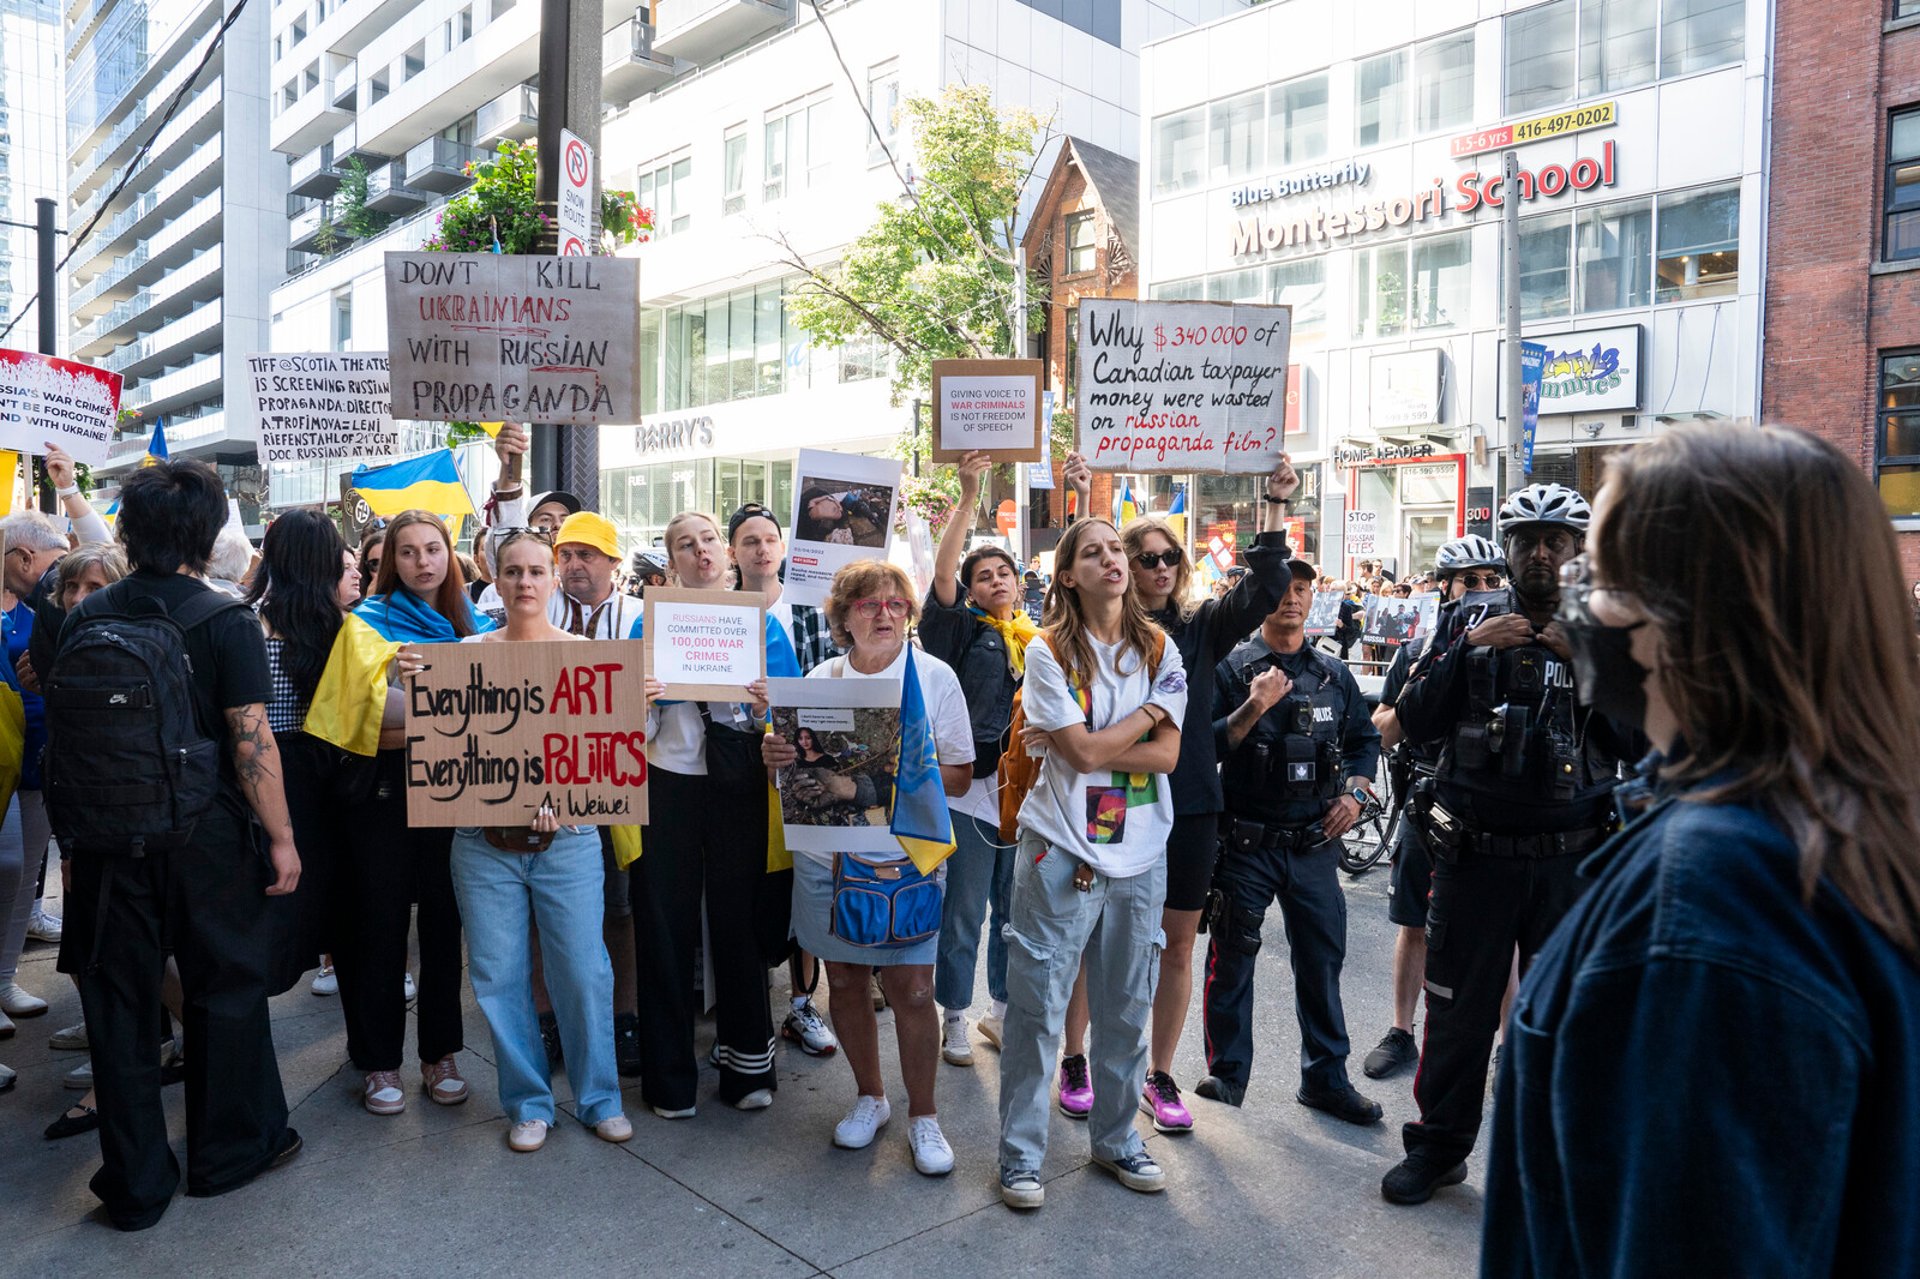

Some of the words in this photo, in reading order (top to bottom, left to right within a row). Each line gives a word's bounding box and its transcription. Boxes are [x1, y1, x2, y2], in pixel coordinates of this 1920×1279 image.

[1453, 135, 1486, 153] 1.5-6
[1489, 131, 1509, 149] yrs
[1517, 106, 1611, 139] 416-497-0202
[1231, 186, 1273, 207] Blue
[1276, 161, 1371, 199] Butterfly
[565, 189, 585, 210] SNOW
[563, 204, 586, 228] ROUTE
[1229, 177, 1447, 257] Montessori
[399, 255, 478, 286] DON'T
[536, 258, 601, 291] KILL
[418, 291, 572, 323] UKRAINIANS
[1089, 308, 1145, 364] Why
[1253, 320, 1280, 348] of
[407, 334, 470, 367] WITH
[500, 334, 609, 367] RUSSIAN
[248, 357, 277, 373] TIFF
[340, 357, 390, 372] THEATRE
[1093, 351, 1195, 385] Canadian
[1200, 356, 1281, 391] taxpayer
[255, 377, 268, 393] IS
[272, 375, 346, 394] SCREENING
[348, 379, 390, 395] RUSSIAN
[950, 389, 983, 399] GIVING
[983, 389, 1012, 399] VOICE
[1014, 389, 1026, 398] TO
[42, 391, 73, 406] WAR
[75, 399, 111, 416] CRIMES
[411, 380, 615, 417] PROPAGANDA
[951, 401, 973, 410] WAR
[974, 401, 1026, 410] CRIMINALS
[1089, 390, 1154, 417] money
[1163, 393, 1207, 408] were
[1211, 389, 1274, 408] wasted
[23, 402, 41, 413] BE
[44, 405, 107, 429] FORGOTTEN
[950, 412, 960, 421] IS
[961, 412, 981, 421] NOT
[982, 412, 1026, 421] FREEDOM
[1091, 415, 1115, 431] on
[1125, 410, 1201, 430] russian
[25, 416, 59, 430] WITH
[62, 423, 108, 442] UKRAINE!
[963, 423, 976, 432] OF
[977, 423, 1013, 432] SPEECH
[263, 431, 341, 446] RIEFENSTAHL
[341, 433, 355, 444] OF
[1095, 430, 1215, 462] propaganda
[1222, 426, 1276, 456] film?
[297, 446, 348, 460] RUSSIANS
[352, 446, 363, 457] AT
[365, 444, 392, 457] WAR
[1332, 447, 1372, 464] HOME
[1377, 443, 1433, 461] LEADER
[1348, 512, 1376, 523] STOP
[1466, 507, 1491, 521] 300
[1347, 543, 1375, 554] LIES
[672, 613, 717, 624] RUSSIANS
[718, 616, 743, 625] HAVE
[667, 624, 722, 636] COMMITTED
[723, 627, 748, 636] OVER
[1362, 635, 1386, 644] RUSSIA
[671, 636, 715, 649] 100,000
[718, 639, 744, 649] WAR
[685, 651, 729, 662] CRIMES
[682, 663, 692, 672] IN
[694, 664, 733, 673] UKRAINE
[412, 662, 521, 738] Everything
[524, 678, 545, 715] is
[549, 663, 624, 716] ART
[406, 732, 520, 805] Everything
[523, 749, 545, 785] is
[543, 731, 648, 787] POLITICS
[568, 789, 631, 817] Weiwei
